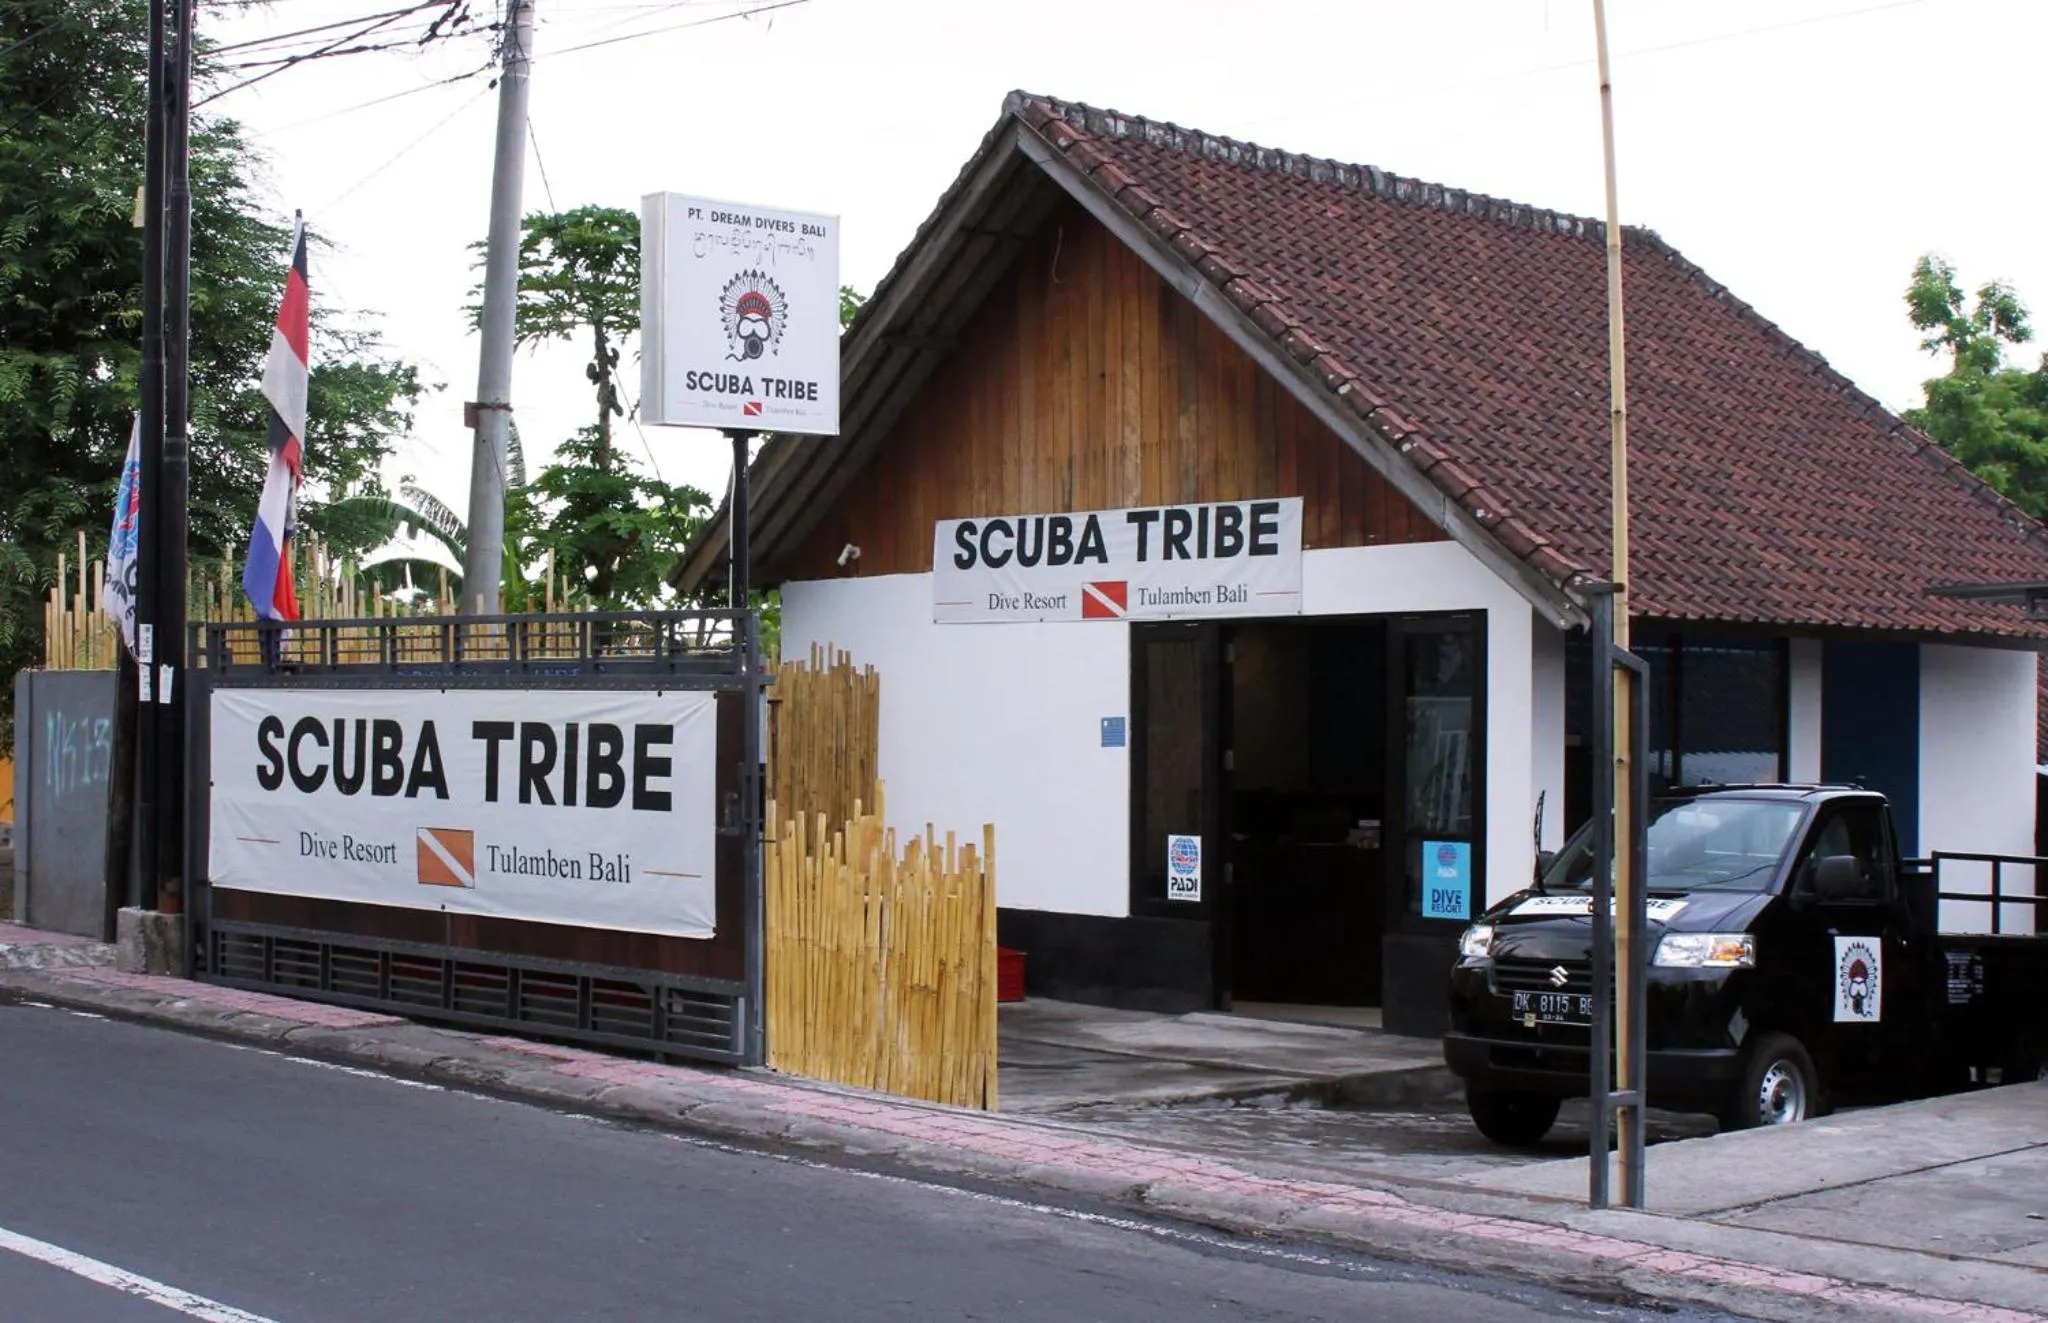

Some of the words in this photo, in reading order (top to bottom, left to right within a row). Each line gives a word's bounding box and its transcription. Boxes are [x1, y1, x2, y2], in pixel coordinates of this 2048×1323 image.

[711, 211, 751, 227] DREAM
[755, 217, 795, 233] DIVERS
[802, 224, 826, 238] BALI
[686, 370, 754, 395] SCUBA
[761, 378, 818, 401] TRIBE
[953, 514, 1108, 570] SCUBA
[1127, 502, 1280, 562] TRIBE
[988, 593, 1021, 610] Dive
[1023, 593, 1067, 610] Resort
[1138, 587, 1211, 607] Tulamben
[1216, 584, 1248, 604] Bali
[256, 715, 450, 800] SCUBA
[472, 720, 675, 812] TRIBE
[300, 831, 339, 861] Dive
[343, 834, 398, 865] Resort
[486, 844, 582, 881] Tulamben
[589, 852, 631, 884] Bali
[1171, 877, 1198, 892] PADI
[1431, 888, 1463, 905] DIVE
[1431, 903, 1463, 914] RESORT
[1534, 897, 1591, 906] SCUB
[1514, 993, 1530, 1011] DK
[1540, 995, 1569, 1013] 8115
